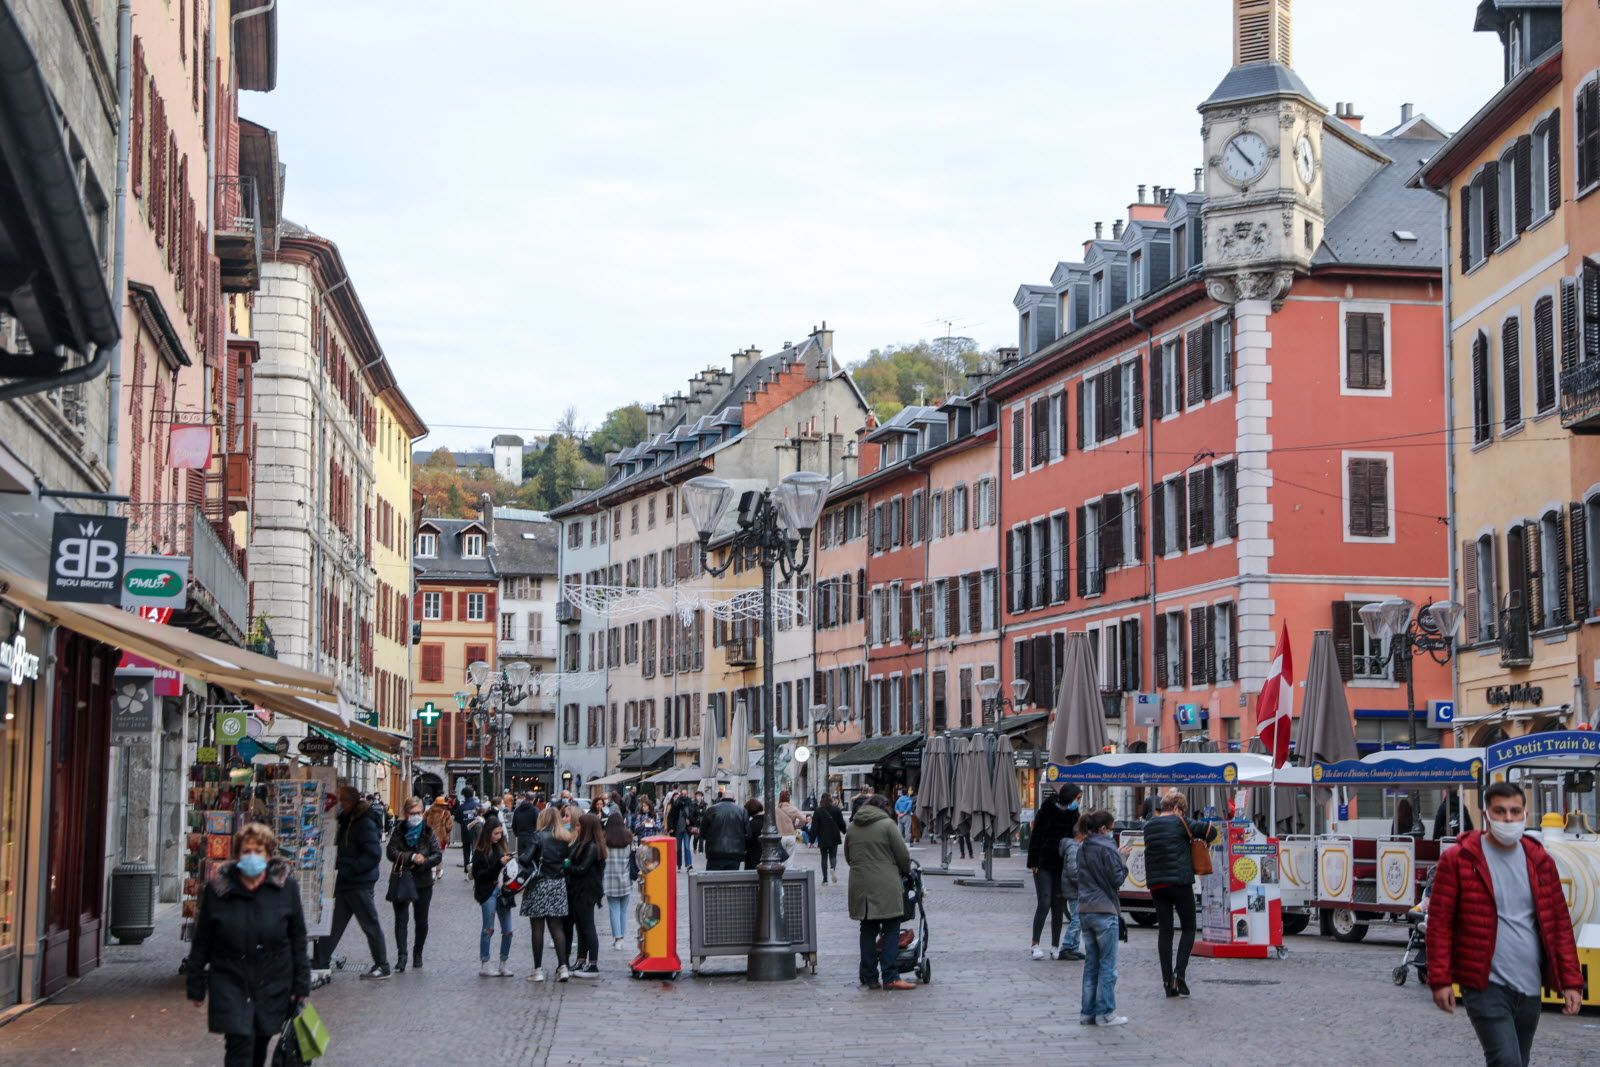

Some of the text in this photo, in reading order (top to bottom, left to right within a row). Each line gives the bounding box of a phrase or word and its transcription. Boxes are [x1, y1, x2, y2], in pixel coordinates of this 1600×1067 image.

[56, 578, 114, 589] BIJOU BRIGITTE
[128, 577, 158, 589] PMU
[1180, 708, 1194, 722] CIC
[1496, 736, 1596, 760] Le Petit Train de
